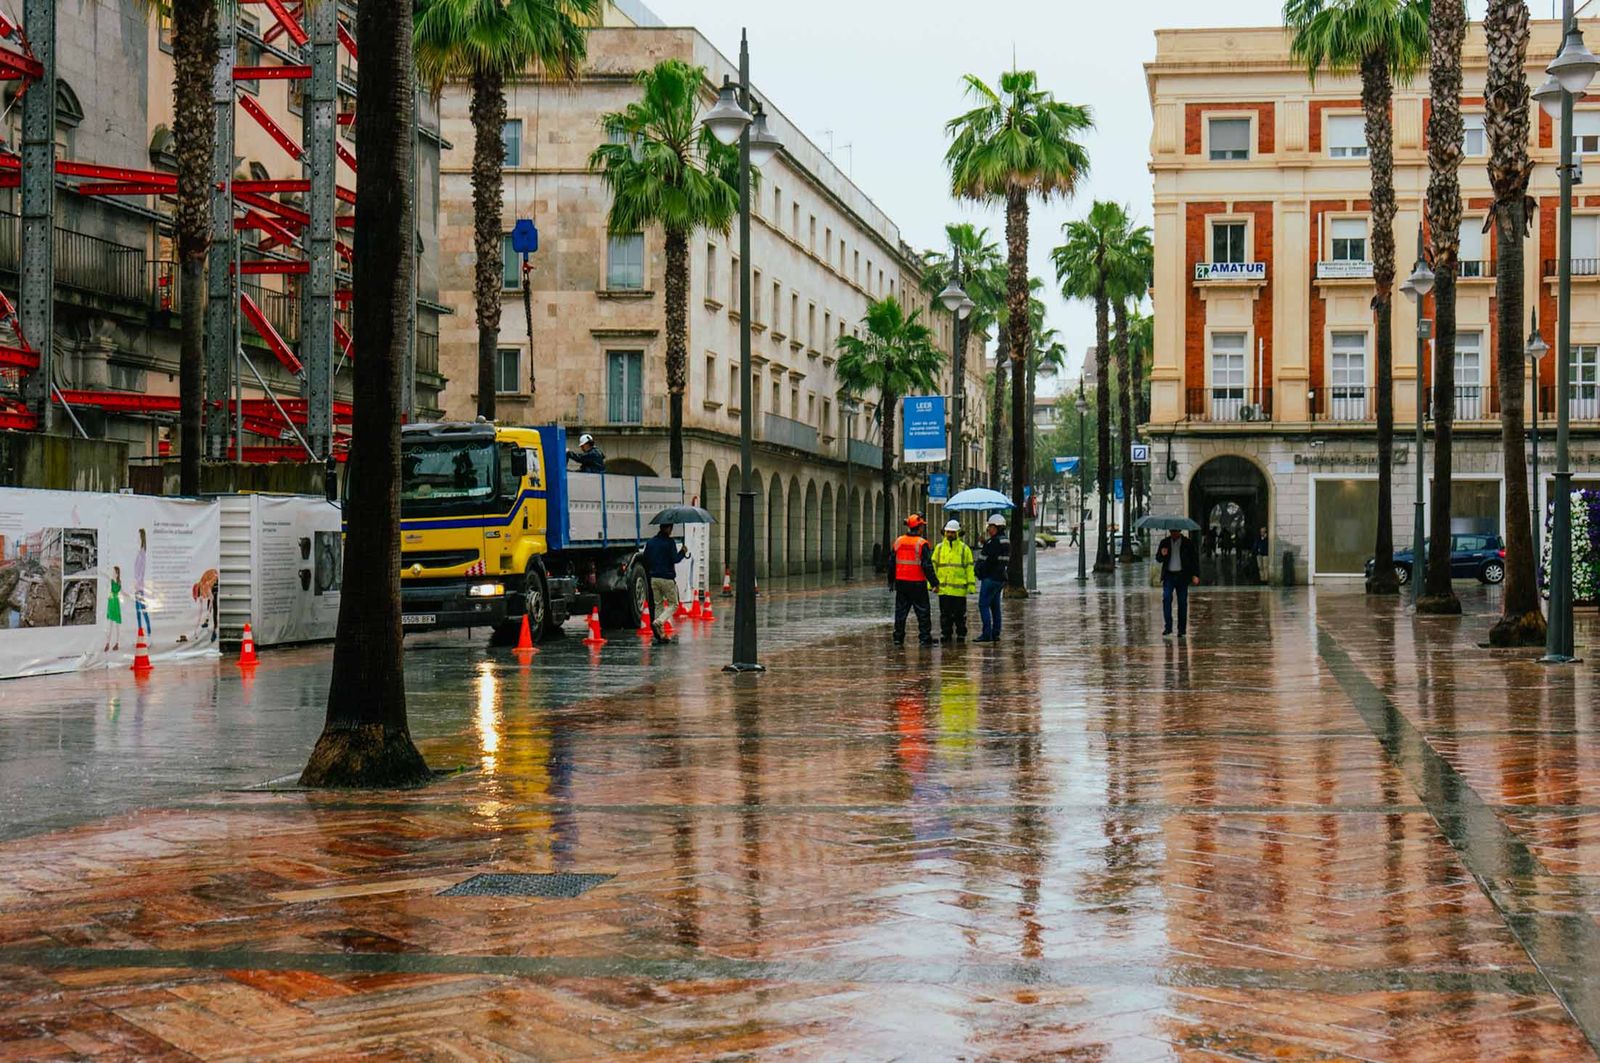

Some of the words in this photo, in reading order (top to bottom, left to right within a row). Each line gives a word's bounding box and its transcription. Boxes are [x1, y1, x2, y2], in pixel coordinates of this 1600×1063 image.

[1211, 263, 1264, 273] AMATUR
[916, 401, 932, 409] LEER
[1294, 454, 1350, 465] Deutsche
[1354, 454, 1379, 465] Ban
